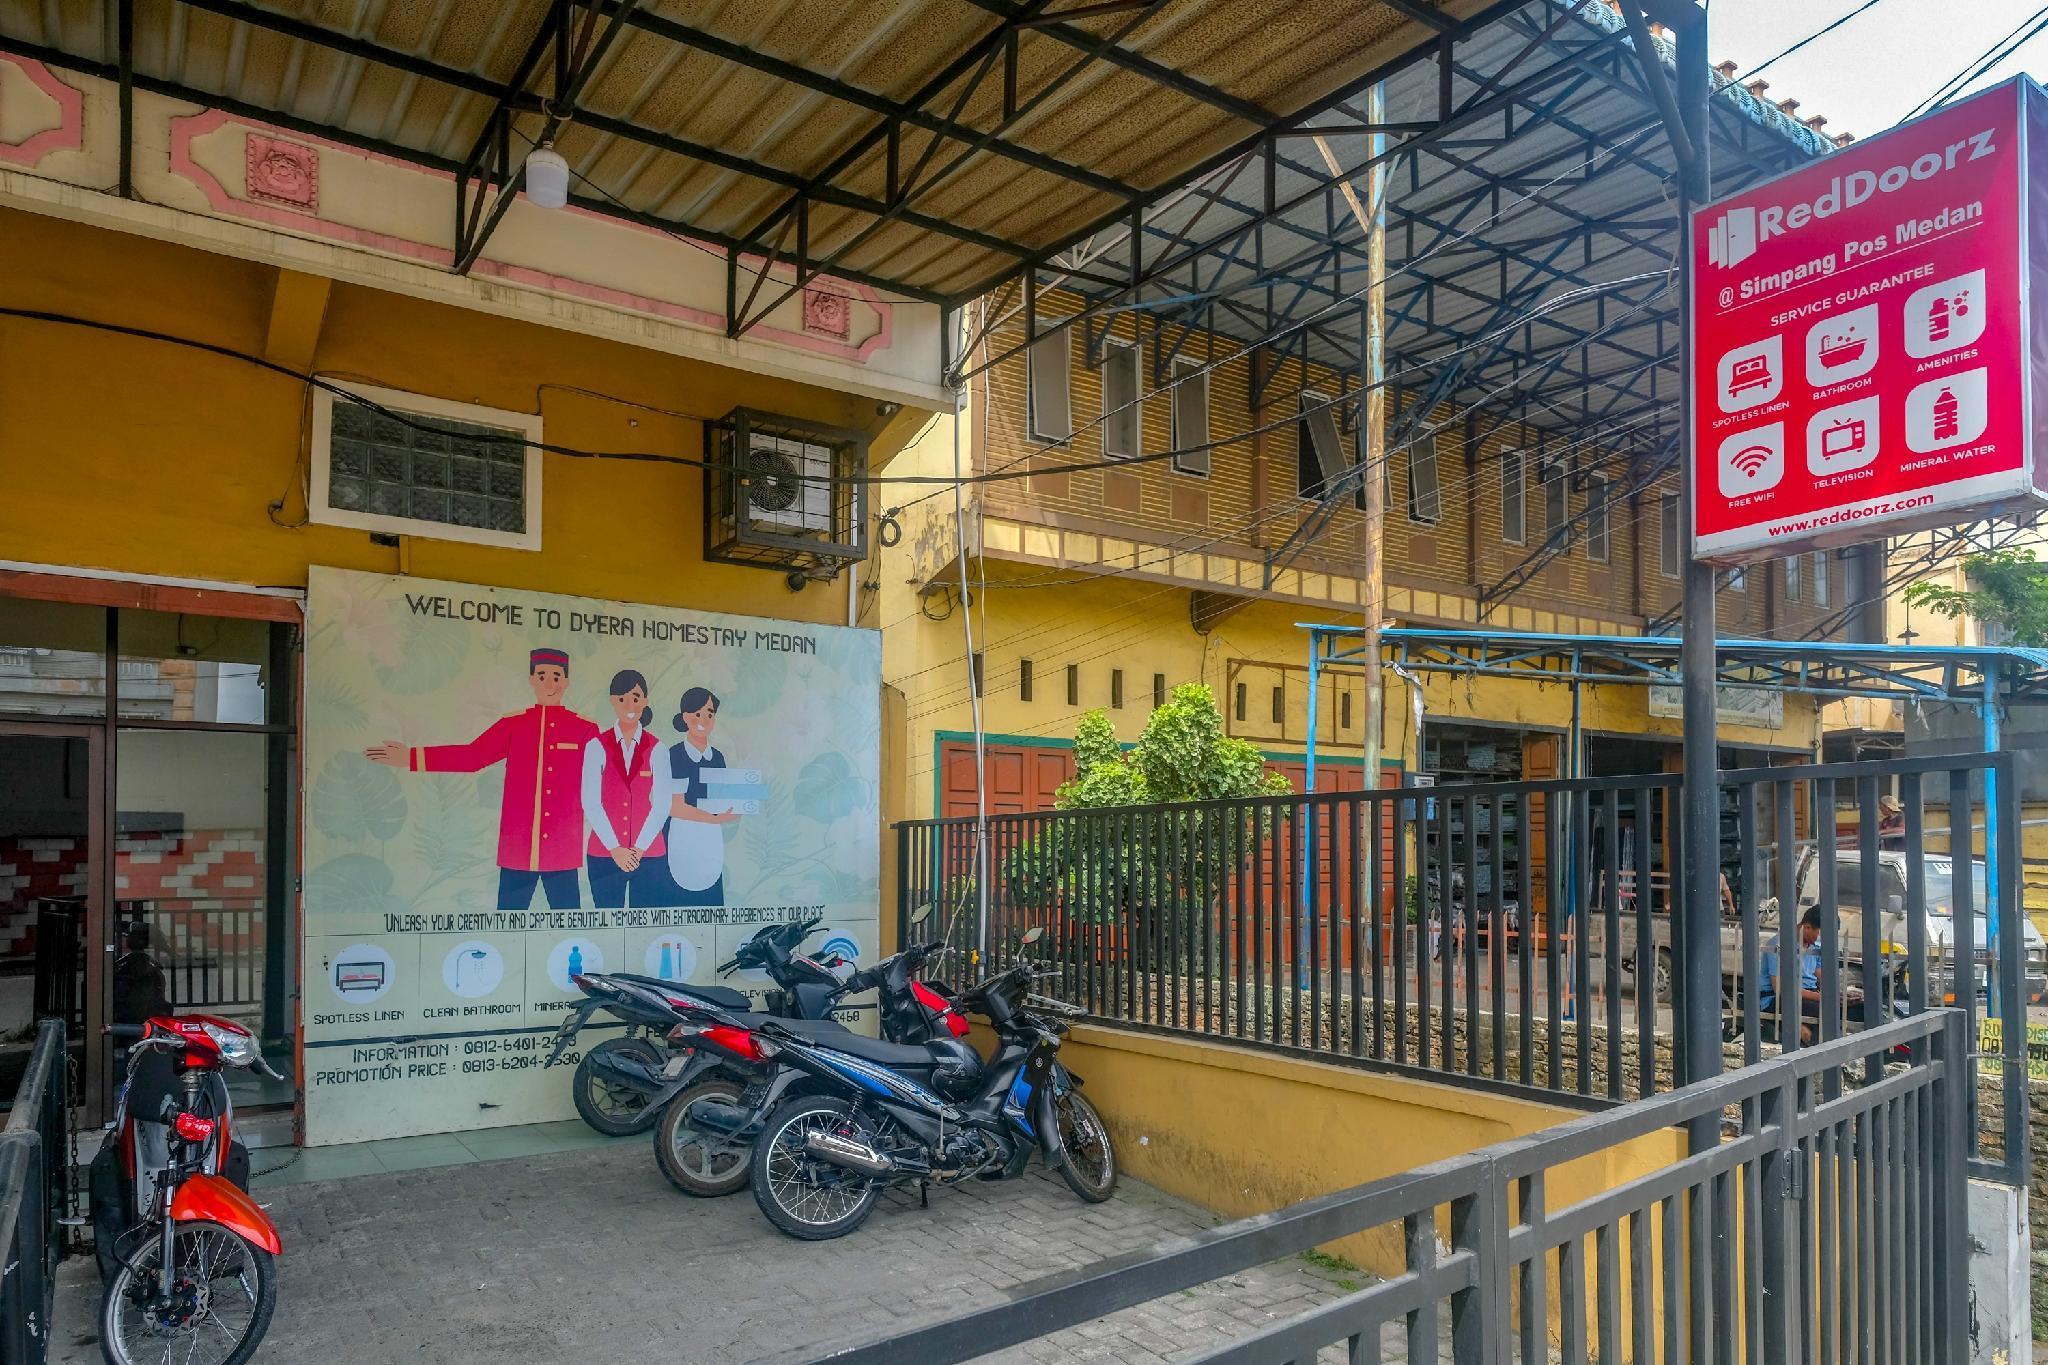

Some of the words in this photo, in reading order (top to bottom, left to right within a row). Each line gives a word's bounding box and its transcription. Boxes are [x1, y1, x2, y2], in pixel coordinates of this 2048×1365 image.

[1759, 127, 1996, 242] RedDoorz
[1718, 286, 1734, 308] @
[1739, 253, 1836, 300] Simpang
[1844, 233, 1888, 263] Pos
[1895, 200, 1983, 244] Medan
[1770, 297, 1832, 327] SERVICE
[1835, 263, 1935, 305] GUARANTEE
[1916, 348, 1978, 373] AMENITIES
[1812, 377, 1873, 400] BATHROOM
[1712, 411, 1760, 429] SPOTLESS
[1760, 400, 1790, 418] LINEN
[1900, 454, 1951, 473] MINERAL
[1953, 444, 1996, 461] WATER
[1813, 469, 1874, 490] TELEVISION
[1728, 498, 1752, 509] FREE
[1753, 492, 1775, 504] WIFI
[1768, 492, 1934, 537] www.reddoorz.com
[404, 593, 523, 626] WELCOME
[533, 607, 561, 630] TO
[570, 612, 634, 638] DYERA
[642, 619, 747, 648] HOMESTAY
[755, 631, 816, 655] MEDAN
[431, 914, 455, 931] YOUR
[457, 913, 507, 931] CREATIVITY
[509, 912, 527, 929] AND
[529, 912, 565, 929] CAPTURE
[567, 911, 609, 929] BEAUTIFUL
[611, 910, 648, 927] MEMORIES
[650, 909, 671, 926] WITH
[777, 907, 787, 922] AT
[788, 906, 802, 921] OUR
[313, 1012, 370, 1025] SPOTLESS
[374, 1010, 405, 1021] LINEN
[423, 1007, 459, 1018] CLEAN
[463, 1004, 521, 1016] BATHROOM
[534, 1001, 577, 1011] MINERA
[353, 1044, 449, 1063] INFORMATION
[316, 1066, 401, 1085] PROMOTION
[408, 1062, 447, 1078] PRICE
